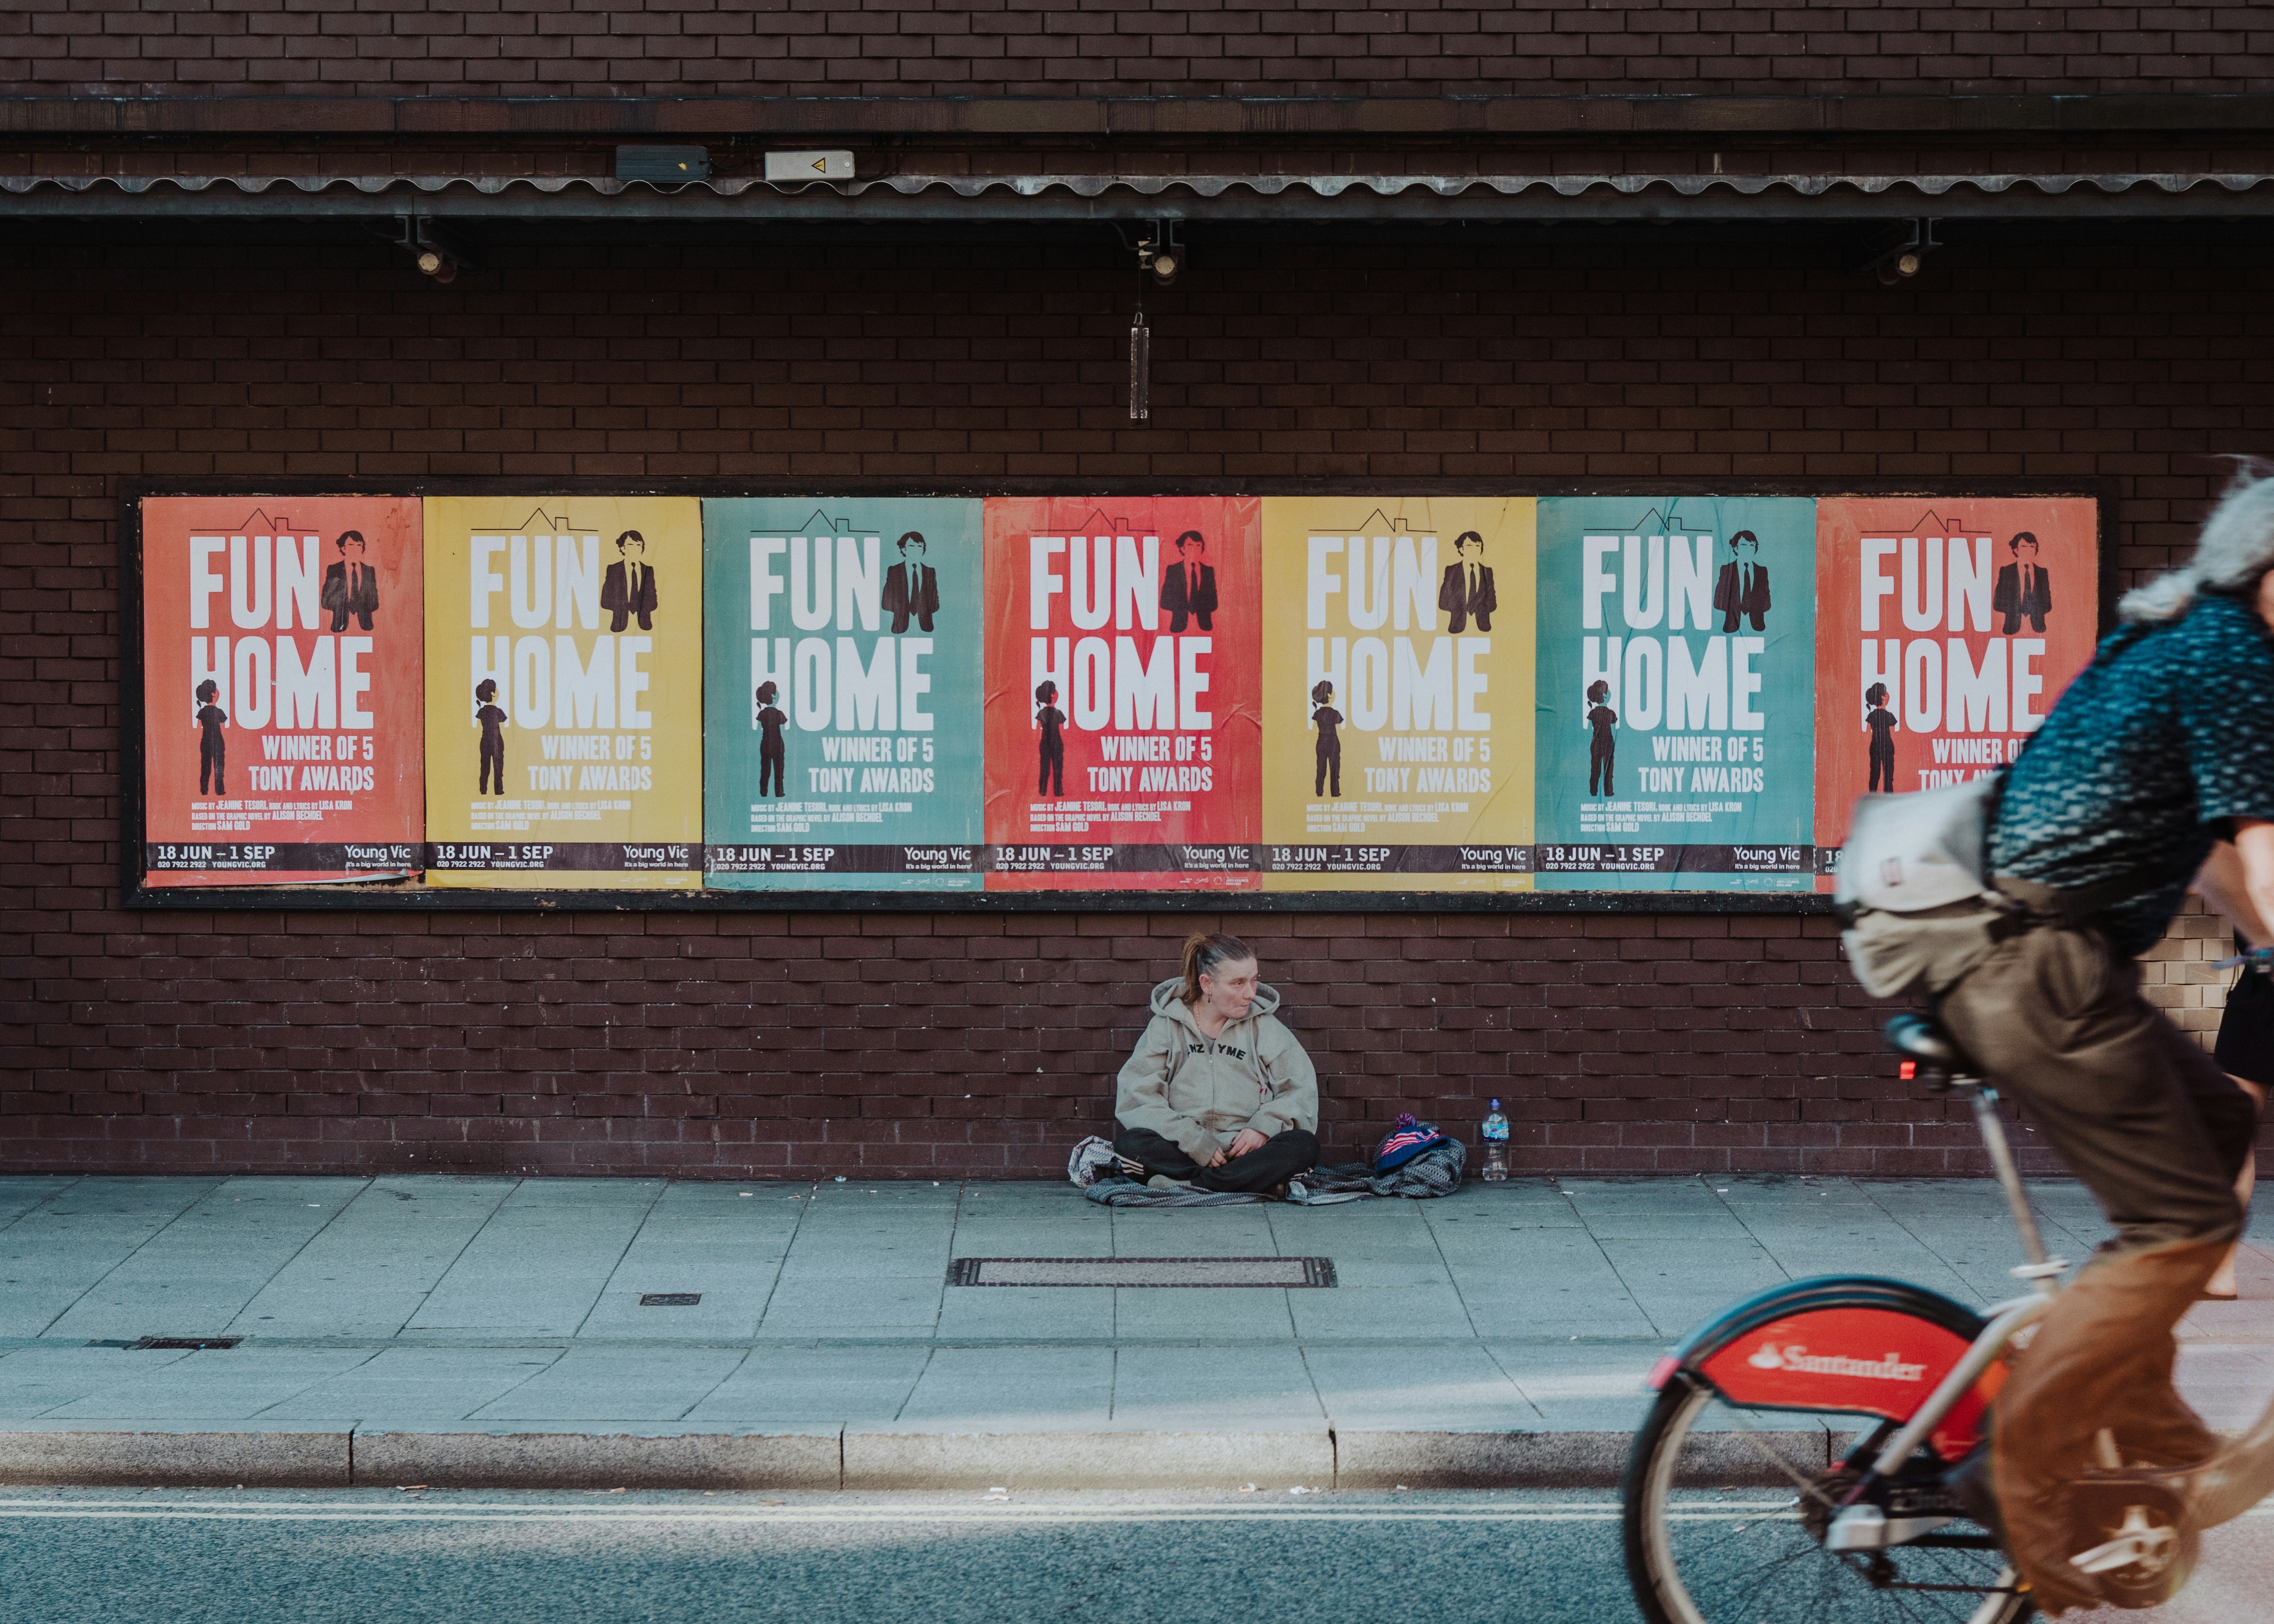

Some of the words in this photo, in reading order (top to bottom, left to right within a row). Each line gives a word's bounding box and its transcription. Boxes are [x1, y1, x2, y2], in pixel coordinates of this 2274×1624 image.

[190, 536, 320, 629] FUN
[470, 536, 599, 629] FUN
[750, 537, 880, 631] FUN
[1030, 536, 1159, 630] FUN
[1307, 536, 1437, 631] FUN
[1582, 535, 1713, 630] FUN
[1860, 538, 1992, 632] FUN
[191, 636, 373, 730] HOME
[471, 635, 652, 730] HOME
[751, 637, 934, 731] HOME
[1031, 637, 1212, 731] HOME
[1307, 636, 1491, 732] HOME
[1582, 636, 1765, 731] HOME
[1861, 639, 2045, 733] HOME
[262, 736, 332, 760] WINNER
[336, 736, 357, 760] OF
[363, 736, 374, 760] 5
[541, 735, 610, 760] WINNER
[615, 736, 636, 760] OF
[640, 736, 651, 760] 5
[822, 737, 892, 762] WINNER
[897, 737, 917, 762] OF
[923, 738, 934, 762] 5
[1101, 736, 1170, 761] WINNER
[1175, 736, 1196, 761] OF
[1201, 736, 1212, 761] 5
[1378, 737, 1448, 762] WINNER
[1453, 737, 1474, 762] OF
[1479, 738, 1490, 762] 5
[1652, 736, 1722, 761] WINNER
[1727, 737, 1748, 762] OF
[1753, 737, 1764, 762] 5
[1932, 739, 2002, 763] WINNER
[249, 766, 295, 790] TONY
[300, 766, 374, 790] AWARDS
[527, 766, 573, 790] TONY
[579, 765, 652, 790] AWARDS
[808, 768, 854, 793] TONY
[860, 768, 934, 793] AWARDS
[1087, 767, 1133, 792] TONY
[1139, 767, 1212, 792] AWARDS
[1364, 767, 1411, 792] TONY
[1416, 767, 1490, 793] AWARDS
[1638, 767, 1684, 792] TONY
[1690, 767, 1764, 792] AWARDS
[158, 846, 176, 859] 18
[180, 846, 212, 859] JUN
[230, 846, 239, 859] 1
[243, 846, 276, 859] SEP
[344, 845, 388, 862] Young
[390, 845, 411, 858] Vic
[437, 845, 456, 859] 18
[459, 845, 491, 859] JUN
[508, 846, 517, 859] 1
[521, 845, 554, 859] SEP
[622, 845, 665, 862] Young
[668, 845, 689, 858] Vic
[717, 848, 735, 861] 18
[739, 848, 771, 861] JUN
[789, 848, 798, 861] 1
[802, 848, 835, 861] SEP
[904, 847, 947, 864] Young
[950, 847, 971, 860] Vic
[996, 847, 1015, 861] 18
[1018, 847, 1051, 861] JUN
[1068, 847, 1077, 861] 1
[1081, 847, 1114, 860] SEP
[1182, 846, 1226, 863] Young
[1228, 846, 1249, 859] Vic
[1272, 848, 1291, 861] 18
[1295, 848, 1327, 861] JUN
[1345, 848, 1354, 861] 1
[1358, 848, 1391, 861] SEP
[1459, 847, 1503, 864] Young
[1505, 847, 1526, 861] Vic
[1546, 847, 1565, 861] 18
[1569, 847, 1601, 861] JUN
[1618, 847, 1628, 861] 1
[1632, 847, 1664, 861] SEP
[1733, 847, 1777, 864] Young
[1779, 847, 1801, 860] Vic
[1783, 1345, 1928, 1381] Santander
